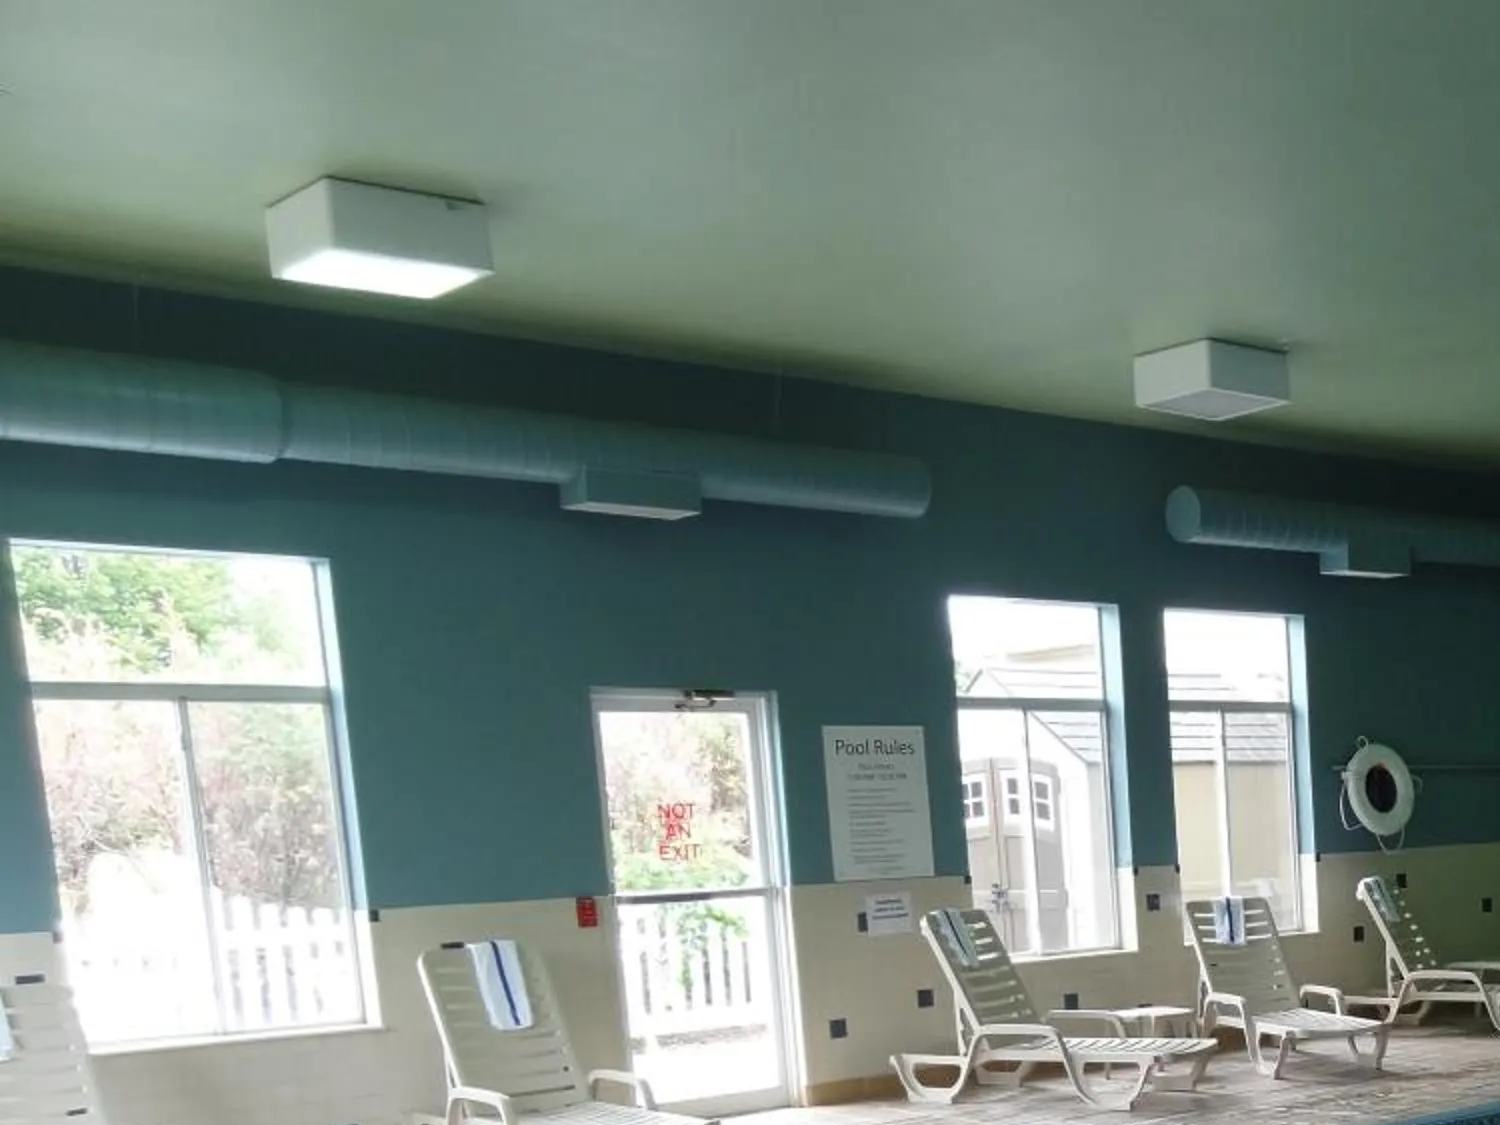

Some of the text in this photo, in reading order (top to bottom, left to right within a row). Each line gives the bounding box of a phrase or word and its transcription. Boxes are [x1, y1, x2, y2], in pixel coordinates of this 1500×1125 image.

[835, 739, 915, 755] Pool Rules
[657, 803, 696, 818] NOT
[665, 822, 691, 840] AN
[659, 843, 702, 861] EXIT
